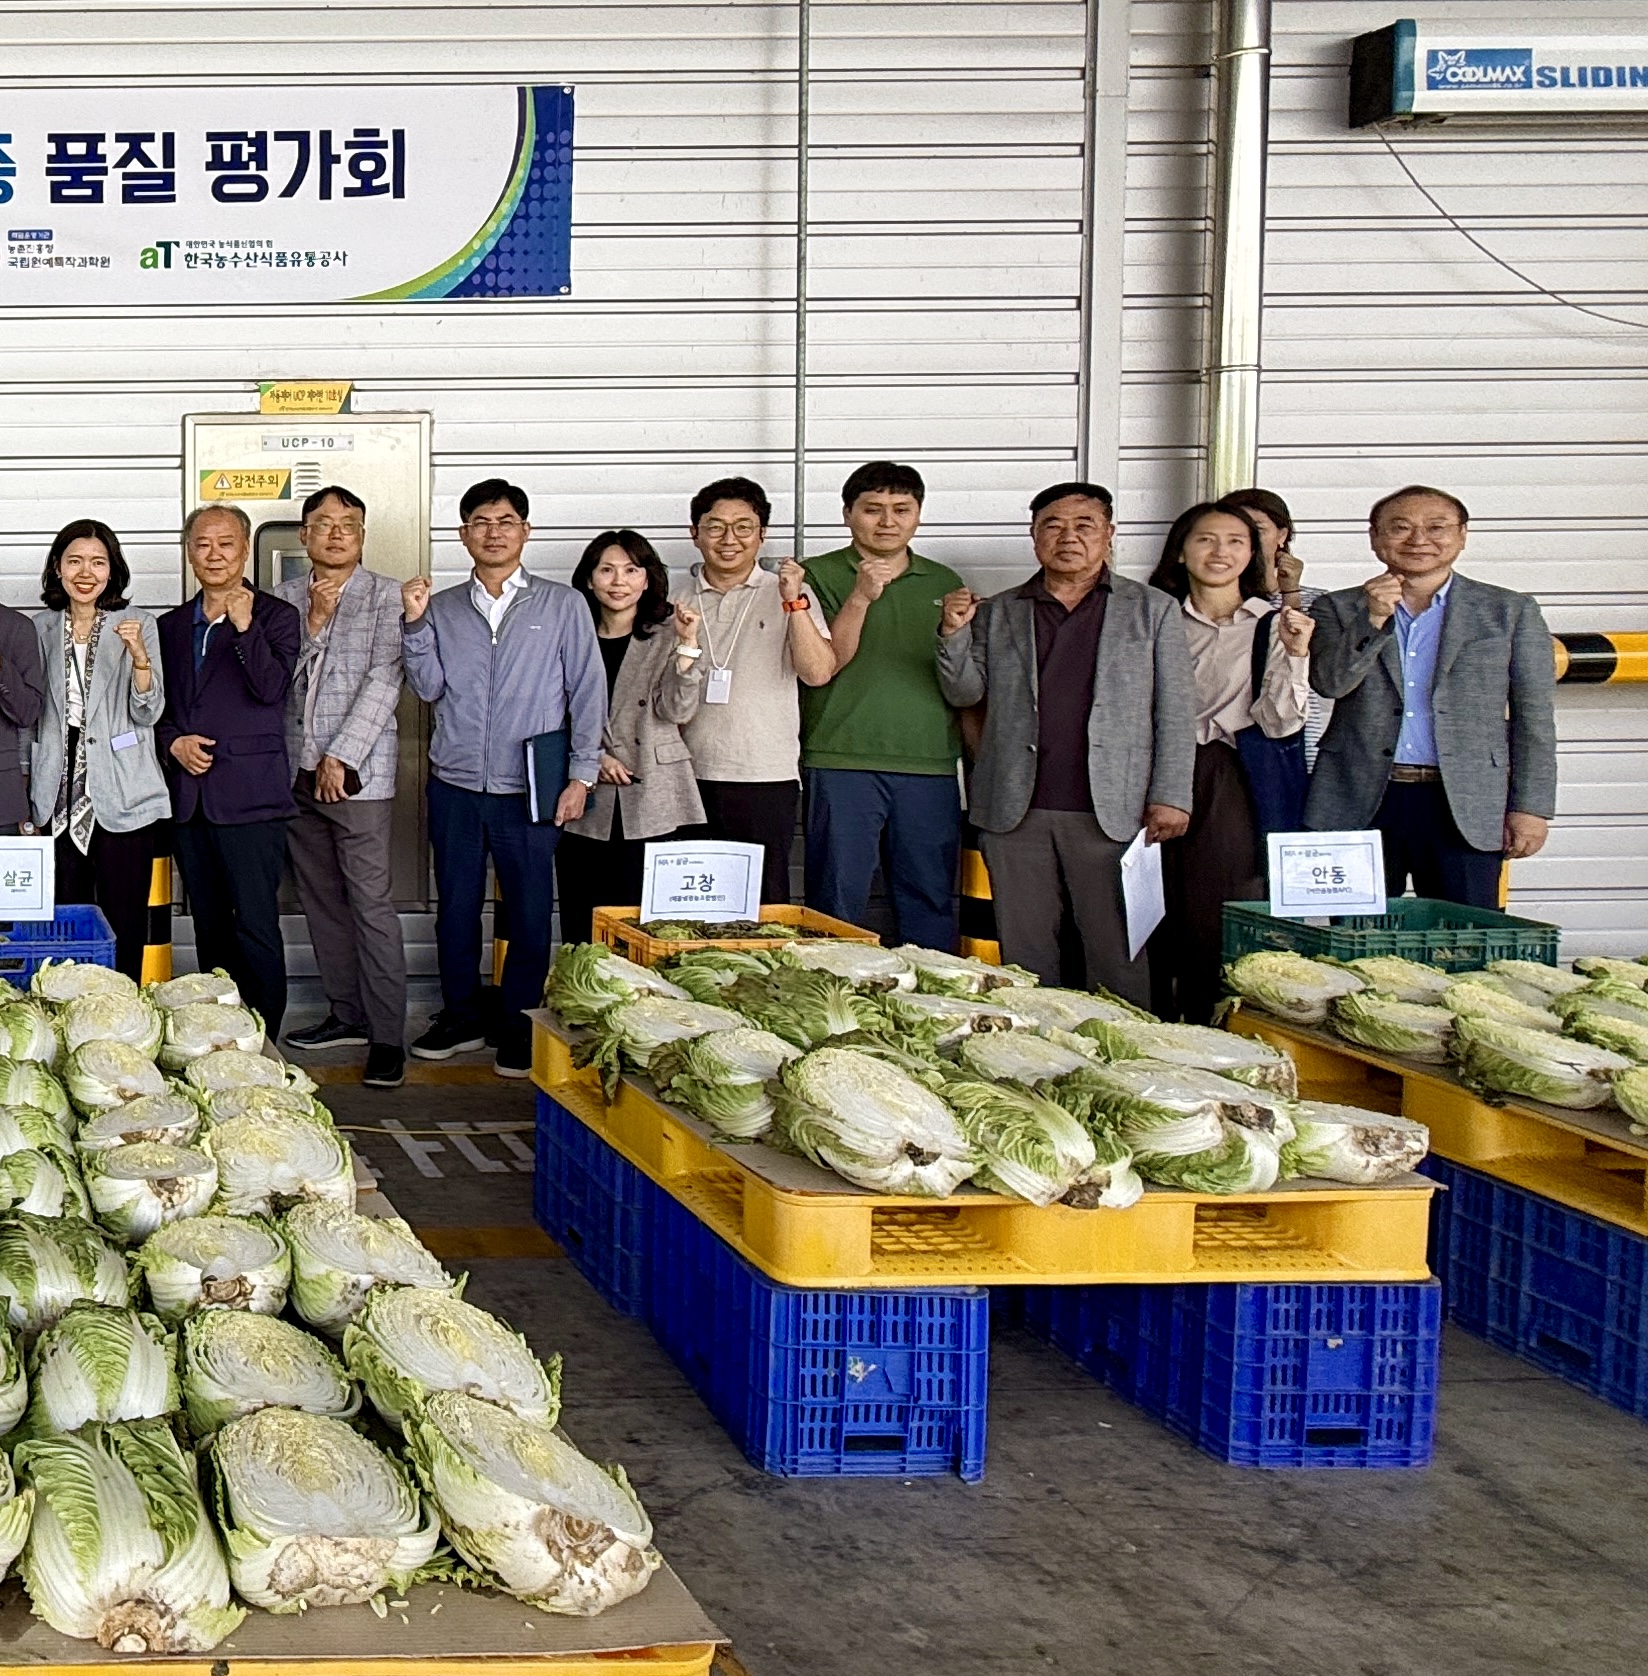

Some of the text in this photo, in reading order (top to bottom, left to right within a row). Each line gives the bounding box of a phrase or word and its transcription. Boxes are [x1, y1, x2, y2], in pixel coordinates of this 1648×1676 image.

[45, 131, 177, 205] 품질
[205, 128, 406, 203] 평가회
[140, 241, 180, 269] aT
[184, 251, 349, 269] 한국농수산식품유통공사
[232, 473, 279, 489] 감전주의
[2, 870, 33, 887] 살균
[680, 873, 716, 892] 고창
[1311, 866, 1347, 885] 안동
